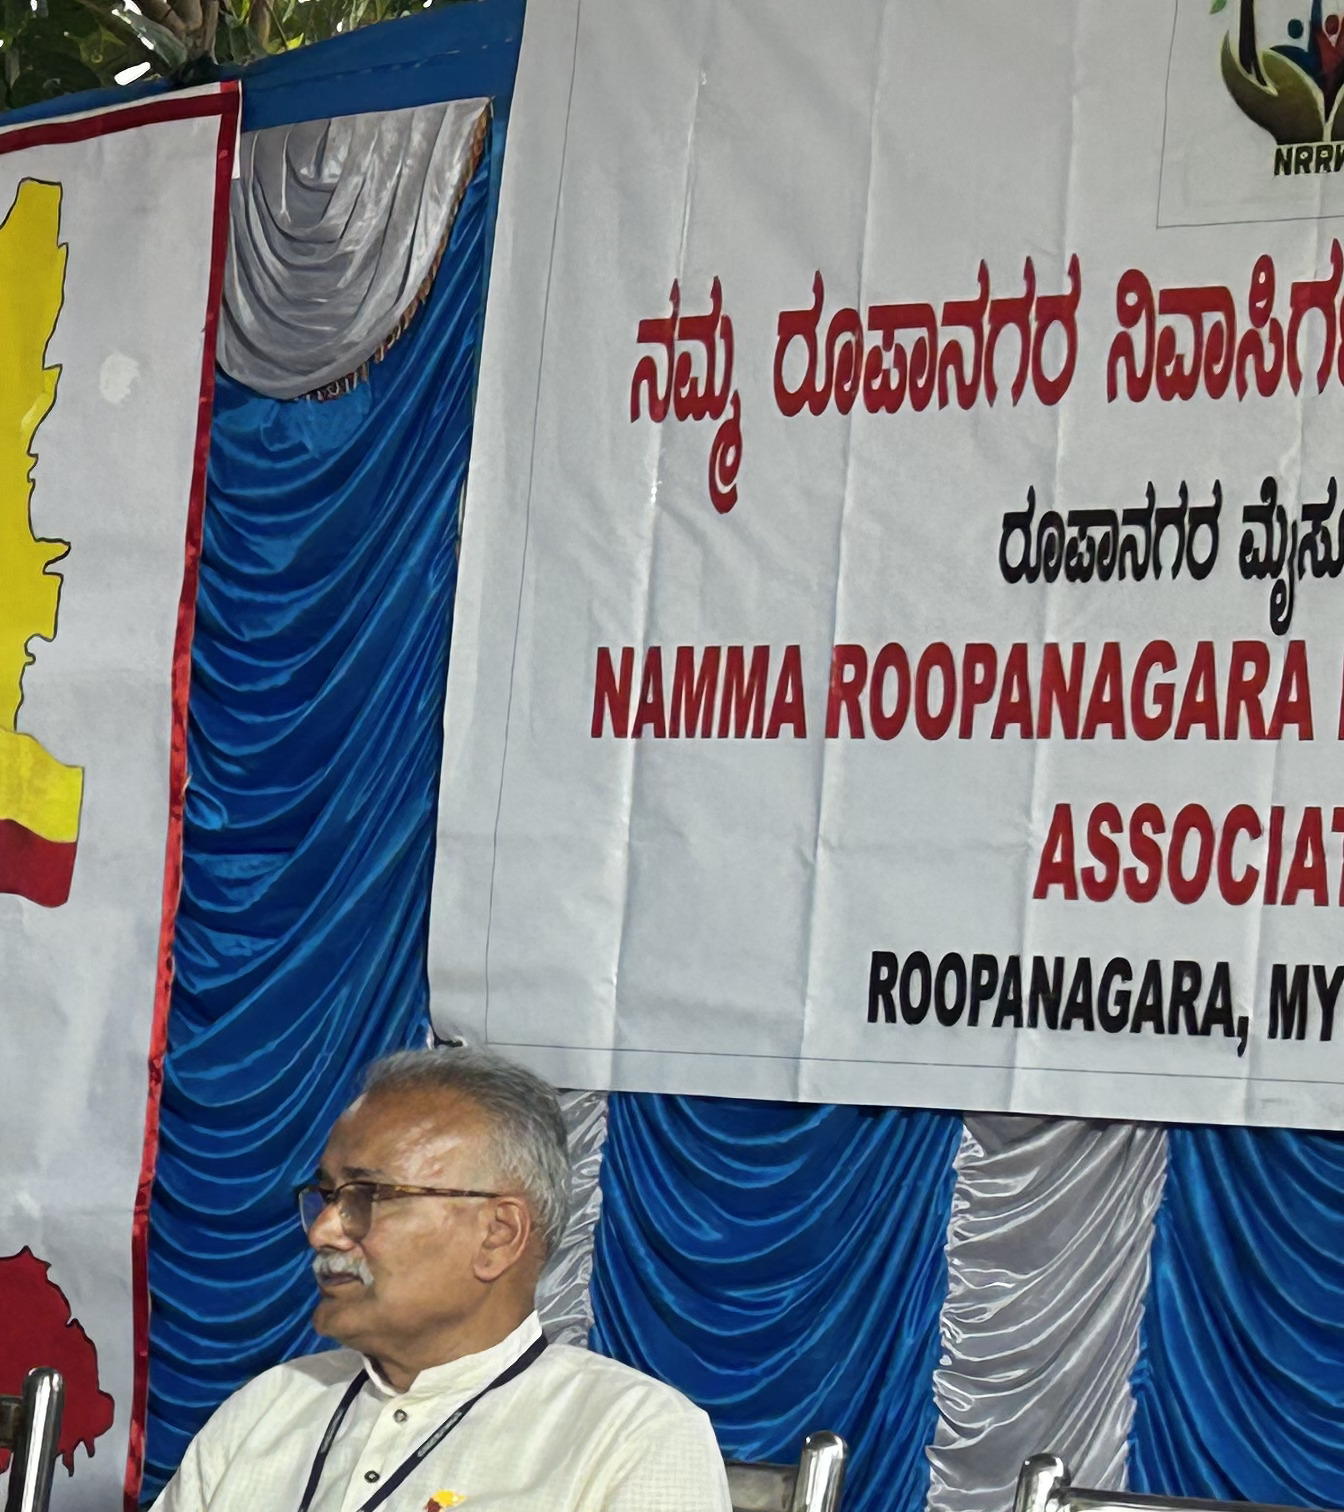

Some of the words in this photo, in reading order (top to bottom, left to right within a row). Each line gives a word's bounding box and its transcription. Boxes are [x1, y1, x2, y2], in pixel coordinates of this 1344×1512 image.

[630, 275, 743, 515] ನಮ್ಮ
[773, 253, 1082, 418] ರೂಪಾನಗರ
[1107, 238, 1344, 403] ನಿವಾಸಿಗ
[998, 478, 1223, 585] ರೂಪಾನಗರ
[590, 645, 808, 741] NAMMA
[824, 639, 1315, 742] ROOPANAGARA
[867, 950, 1250, 1057] ROOPANAGARA,
[1267, 963, 1344, 1042] MY
